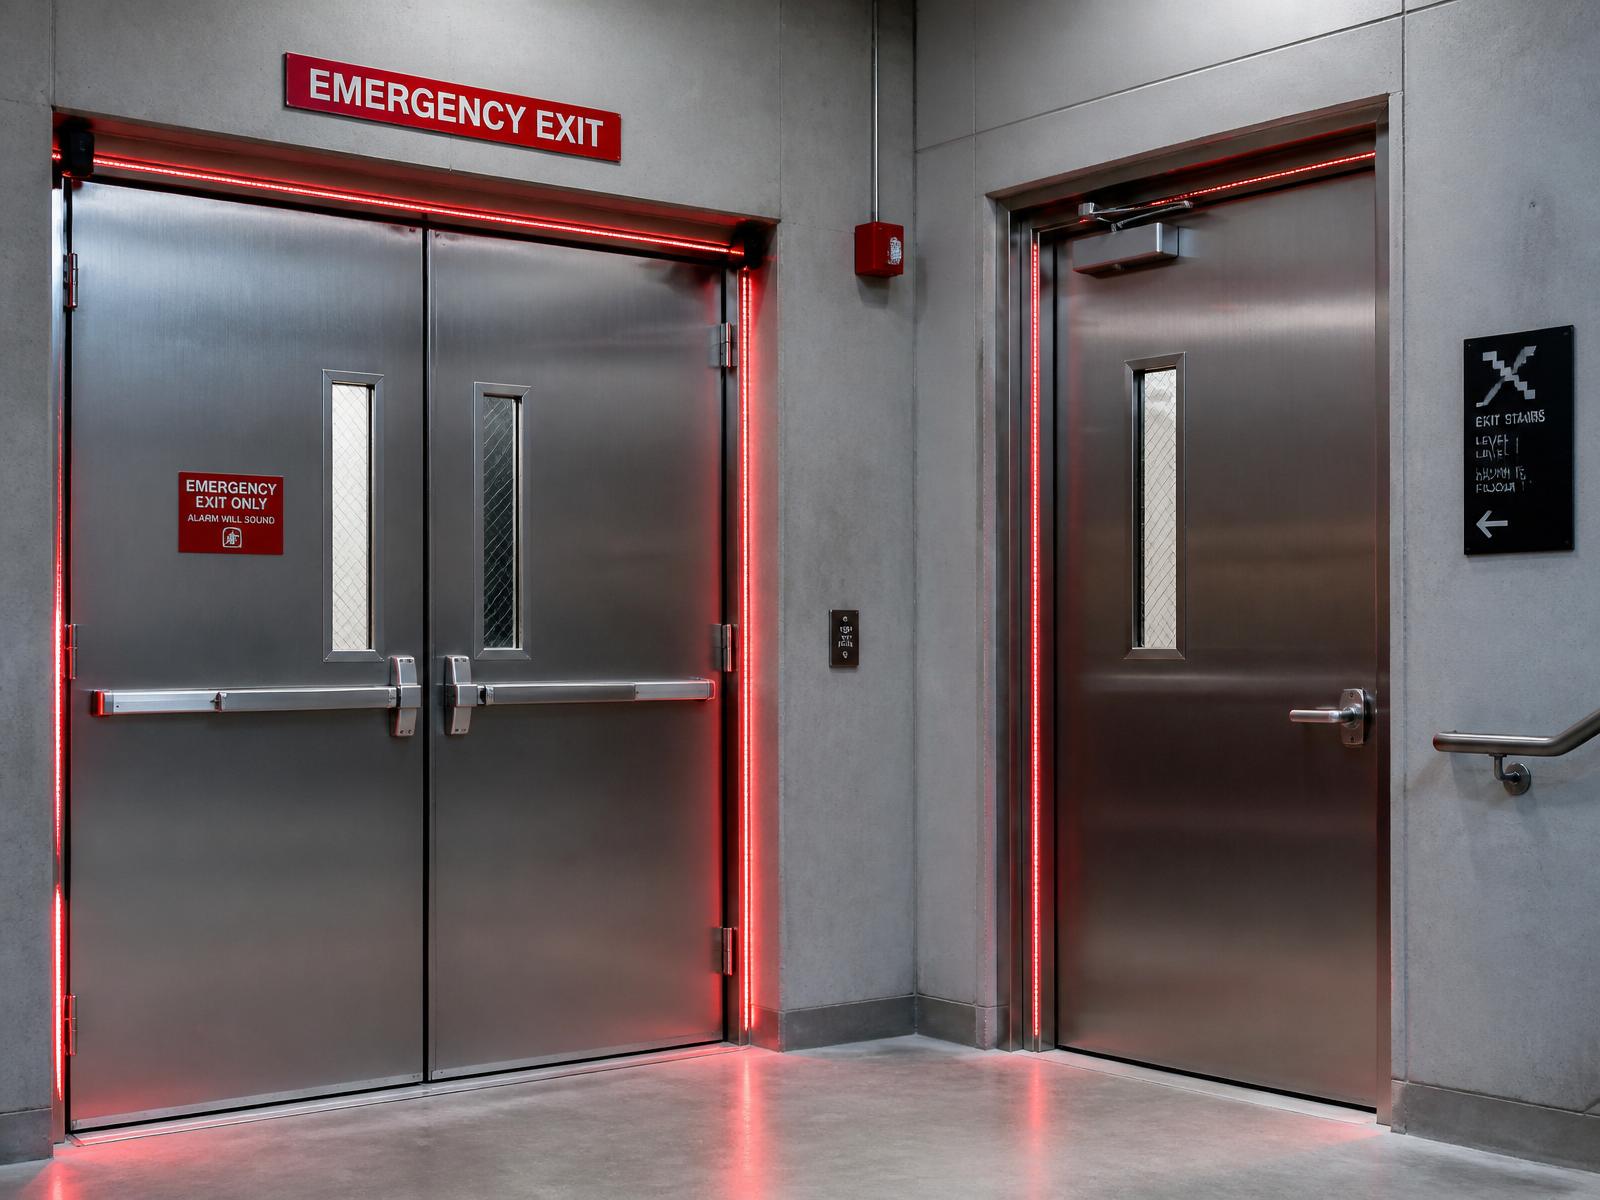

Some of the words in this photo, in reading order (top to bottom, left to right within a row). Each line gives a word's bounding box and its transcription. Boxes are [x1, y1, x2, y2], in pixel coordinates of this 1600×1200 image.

[309, 67, 527, 135] EMERGENCY
[536, 110, 605, 148] EXIT
[186, 479, 277, 496] EMERGENCY
[195, 496, 227, 509] EXIT
[231, 497, 268, 510] ONLY
[187, 514, 219, 523] ALARM
[221, 515, 242, 524] WILL
[244, 516, 275, 525] SOUND
